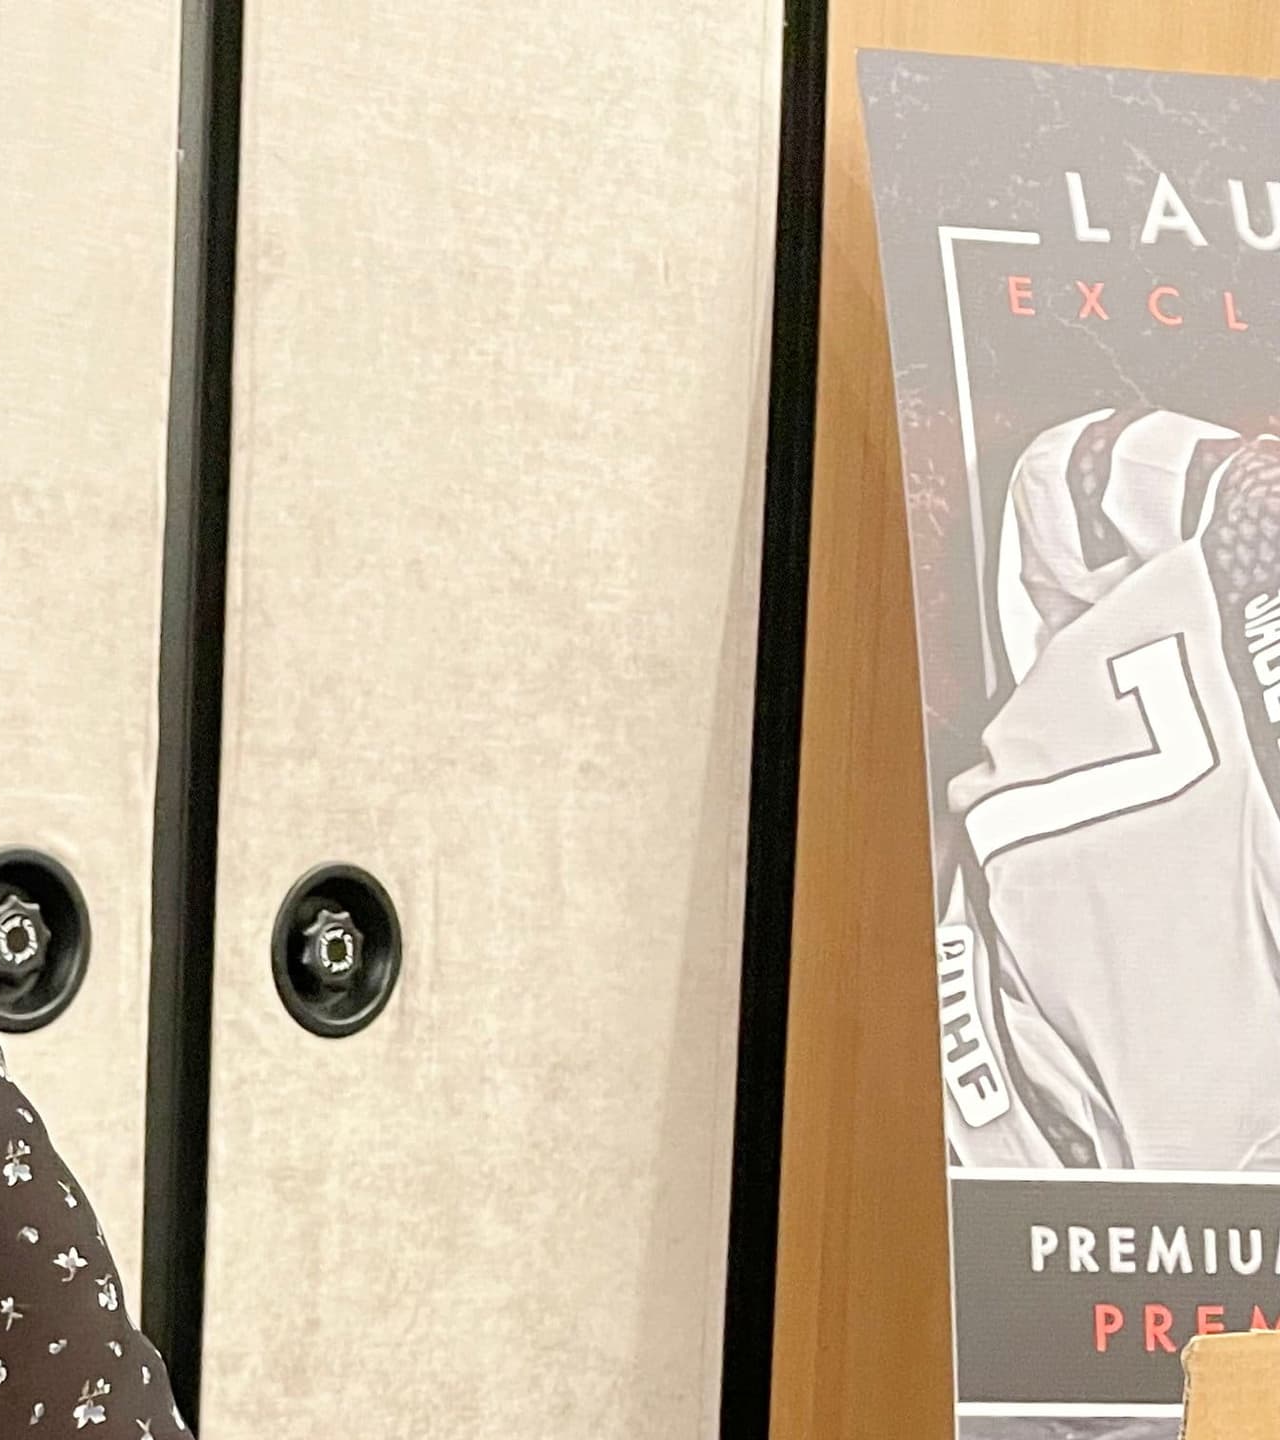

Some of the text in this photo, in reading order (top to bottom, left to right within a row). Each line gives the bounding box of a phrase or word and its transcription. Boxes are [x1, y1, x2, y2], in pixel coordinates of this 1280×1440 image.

[1064, 170, 1280, 251] LAU
[1007, 274, 1249, 331] EXCL
[1030, 1224, 1280, 1276] PREMIU
